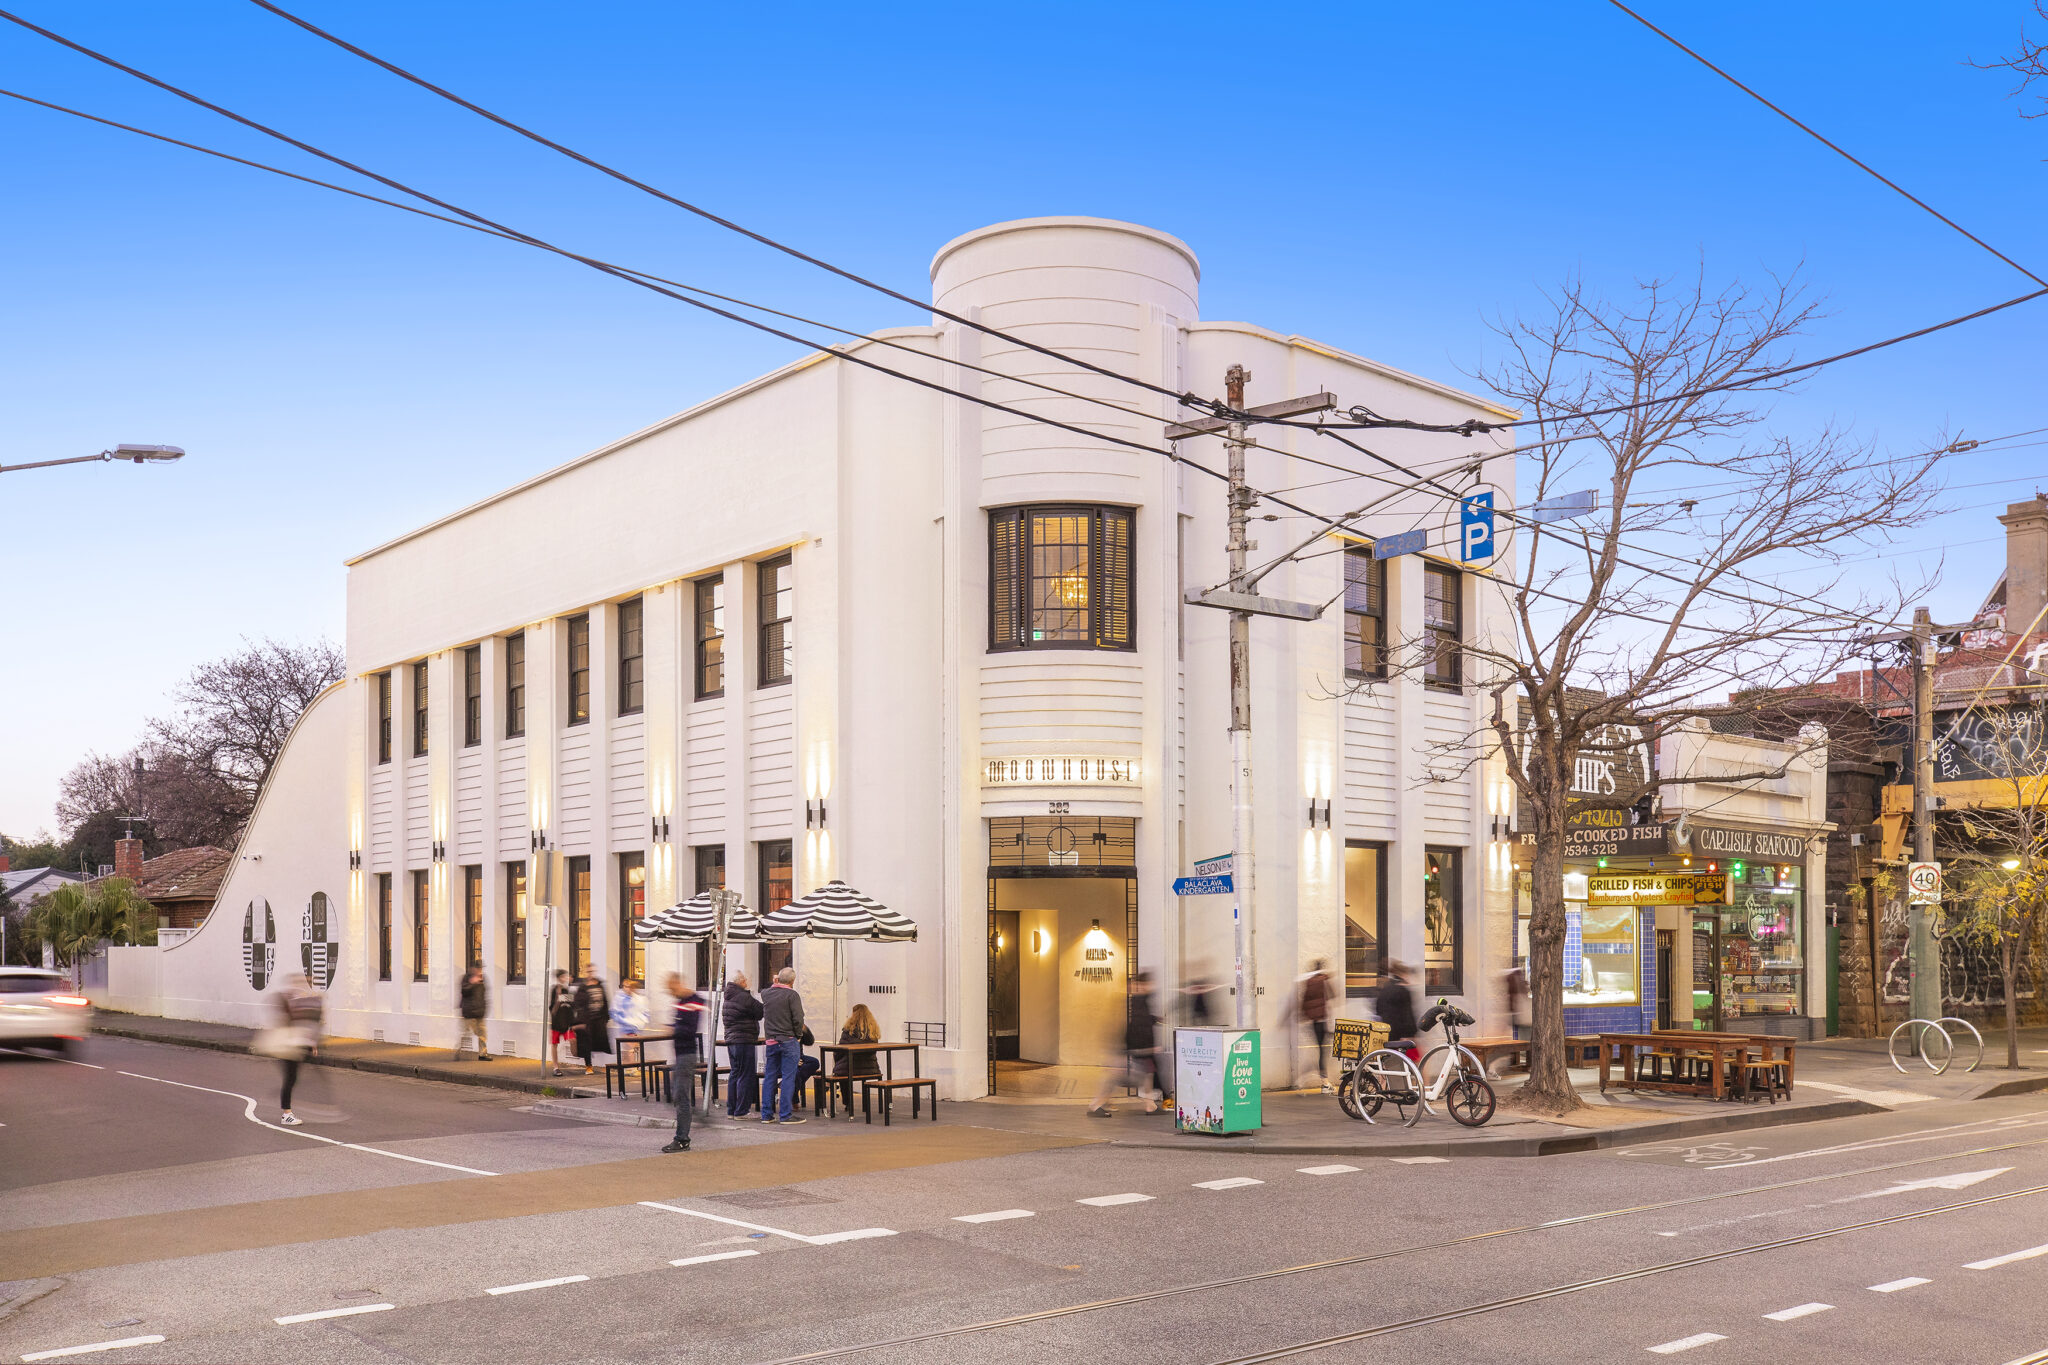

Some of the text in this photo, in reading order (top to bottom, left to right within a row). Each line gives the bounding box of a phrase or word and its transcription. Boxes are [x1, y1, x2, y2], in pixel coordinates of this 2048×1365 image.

[1466, 522, 1489, 559] P
[989, 759, 1134, 782] MOONHOUSE
[1049, 802, 1070, 814] 282
[1573, 827, 1628, 843] COOKED
[1632, 826, 1663, 840] FISH
[1700, 829, 1802, 858] CARLISLE SEAFOOD
[1195, 863, 1222, 877] NELSON
[1184, 879, 1223, 888] BALACLAVA
[1589, 877, 1694, 891] GRILLED FISH & CHIPS
[1695, 875, 1725, 883] FRESH
[1914, 872, 1935, 885] 40
[1178, 886, 1230, 895] KINDERGARTEN
[1588, 891, 1694, 904] Hamburgers Oysters Crayfish
[1181, 1047, 1217, 1056] DIVERCITY
[1236, 1057, 1249, 1067] live
[1233, 1077, 1252, 1086] LOCAL
